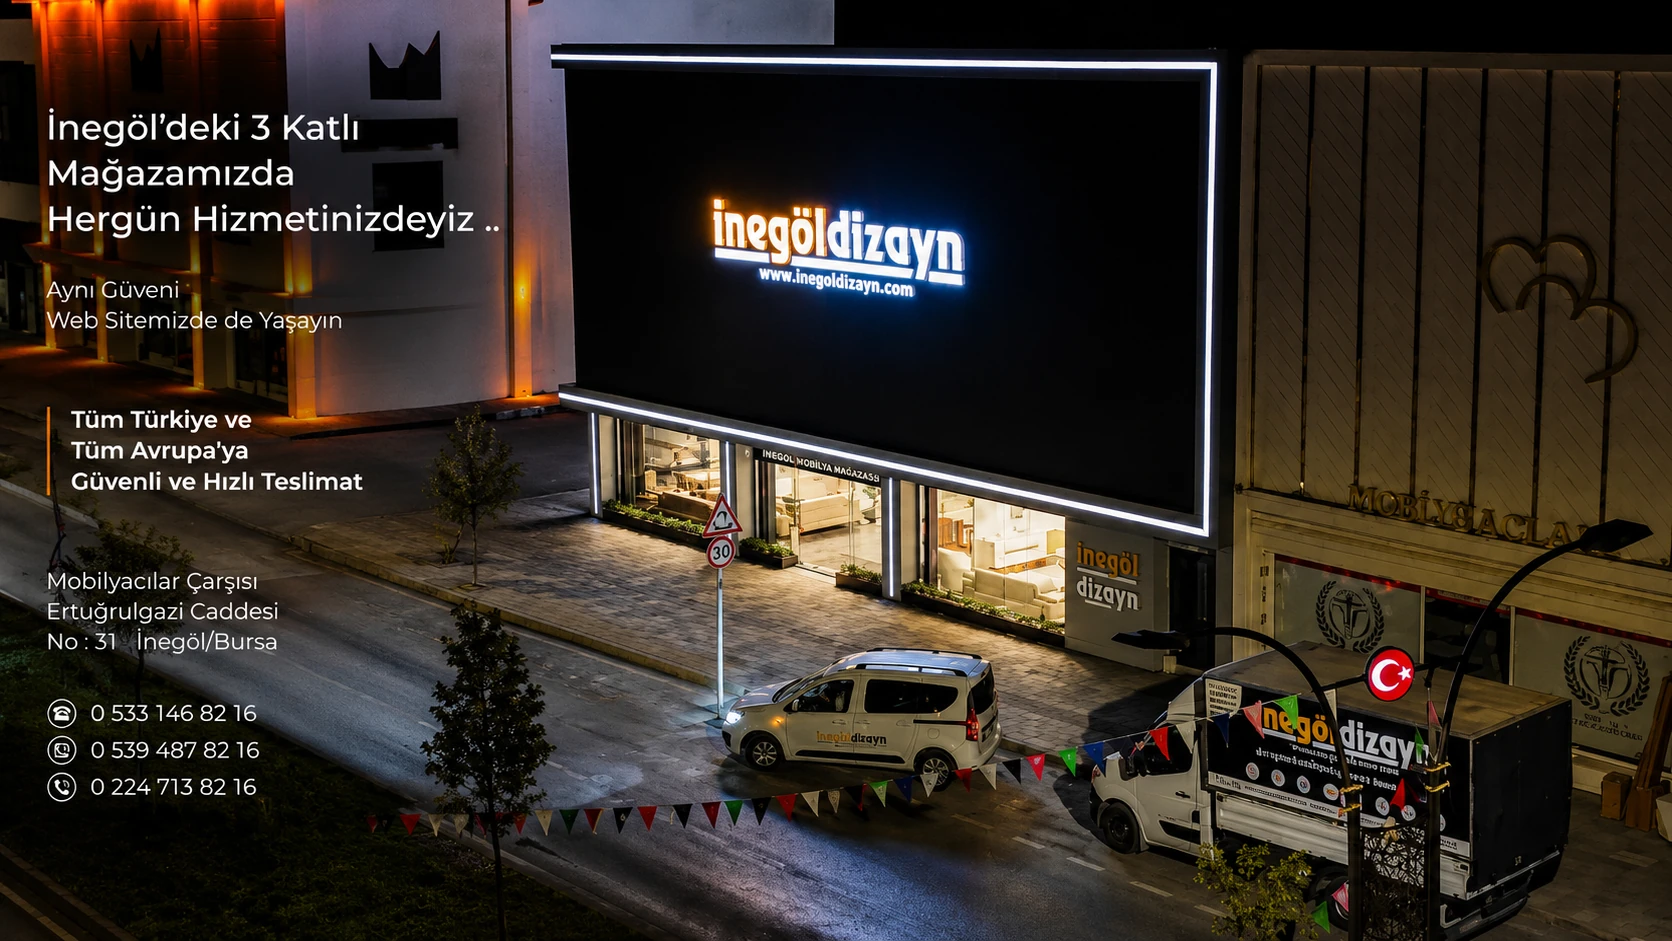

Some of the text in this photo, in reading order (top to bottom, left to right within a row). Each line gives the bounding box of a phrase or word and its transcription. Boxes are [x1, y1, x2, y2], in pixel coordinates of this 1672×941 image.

[759, 267, 915, 297] www.inegoldizayn.com
[796, 457, 833, 474] MOBİLYA
[712, 544, 730, 560] 30
[1077, 541, 1139, 578] inegöl
[1076, 575, 1140, 612] dizayn
